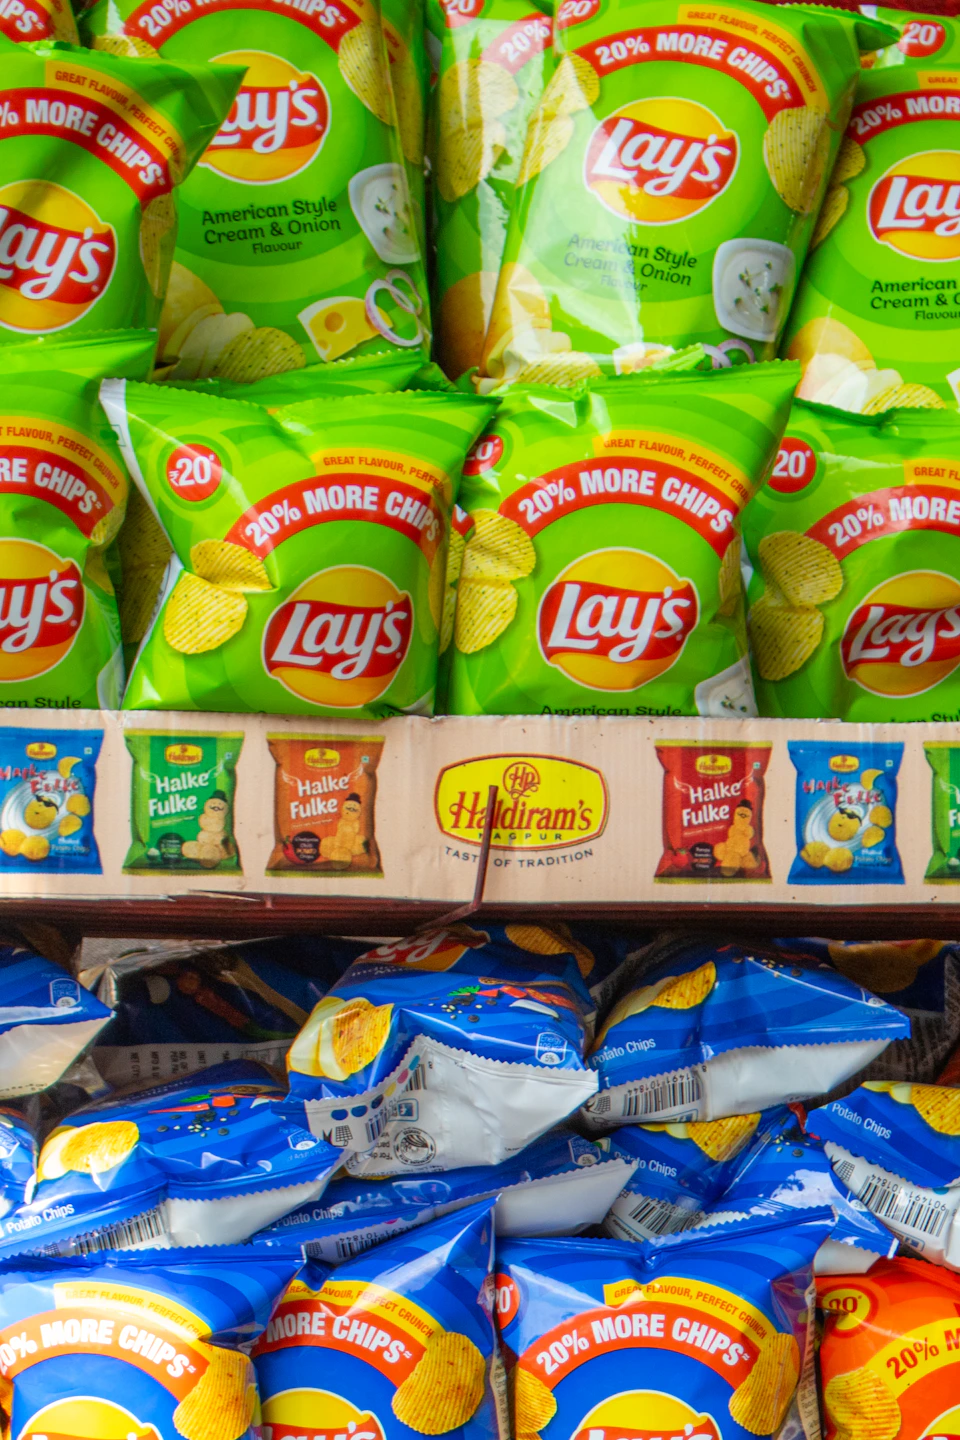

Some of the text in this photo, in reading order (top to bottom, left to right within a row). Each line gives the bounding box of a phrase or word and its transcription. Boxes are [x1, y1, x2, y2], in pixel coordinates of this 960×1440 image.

[595, 35, 650, 67] 20%
[656, 32, 725, 60] MORE
[850, 104, 902, 136] 20%
[591, 119, 731, 196] Lay's
[871, 277, 958, 294] American
[871, 293, 930, 310] Cream
[935, 292, 948, 306] &
[603, 438, 636, 448] GREAT
[548, 584, 690, 662] Lay's
[271, 601, 408, 680] Lay's
[154, 773, 209, 794] Halke
[690, 781, 742, 804] Halke
[148, 795, 198, 817] Fulke
[681, 804, 730, 827] Fulke
[494, 848, 594, 868] OF TRADITION
[831, 1101, 892, 1141] Potato Chips
[536, 1329, 590, 1376] 20%
[591, 1313, 665, 1345] MORE
[886, 1336, 940, 1380] 20%
